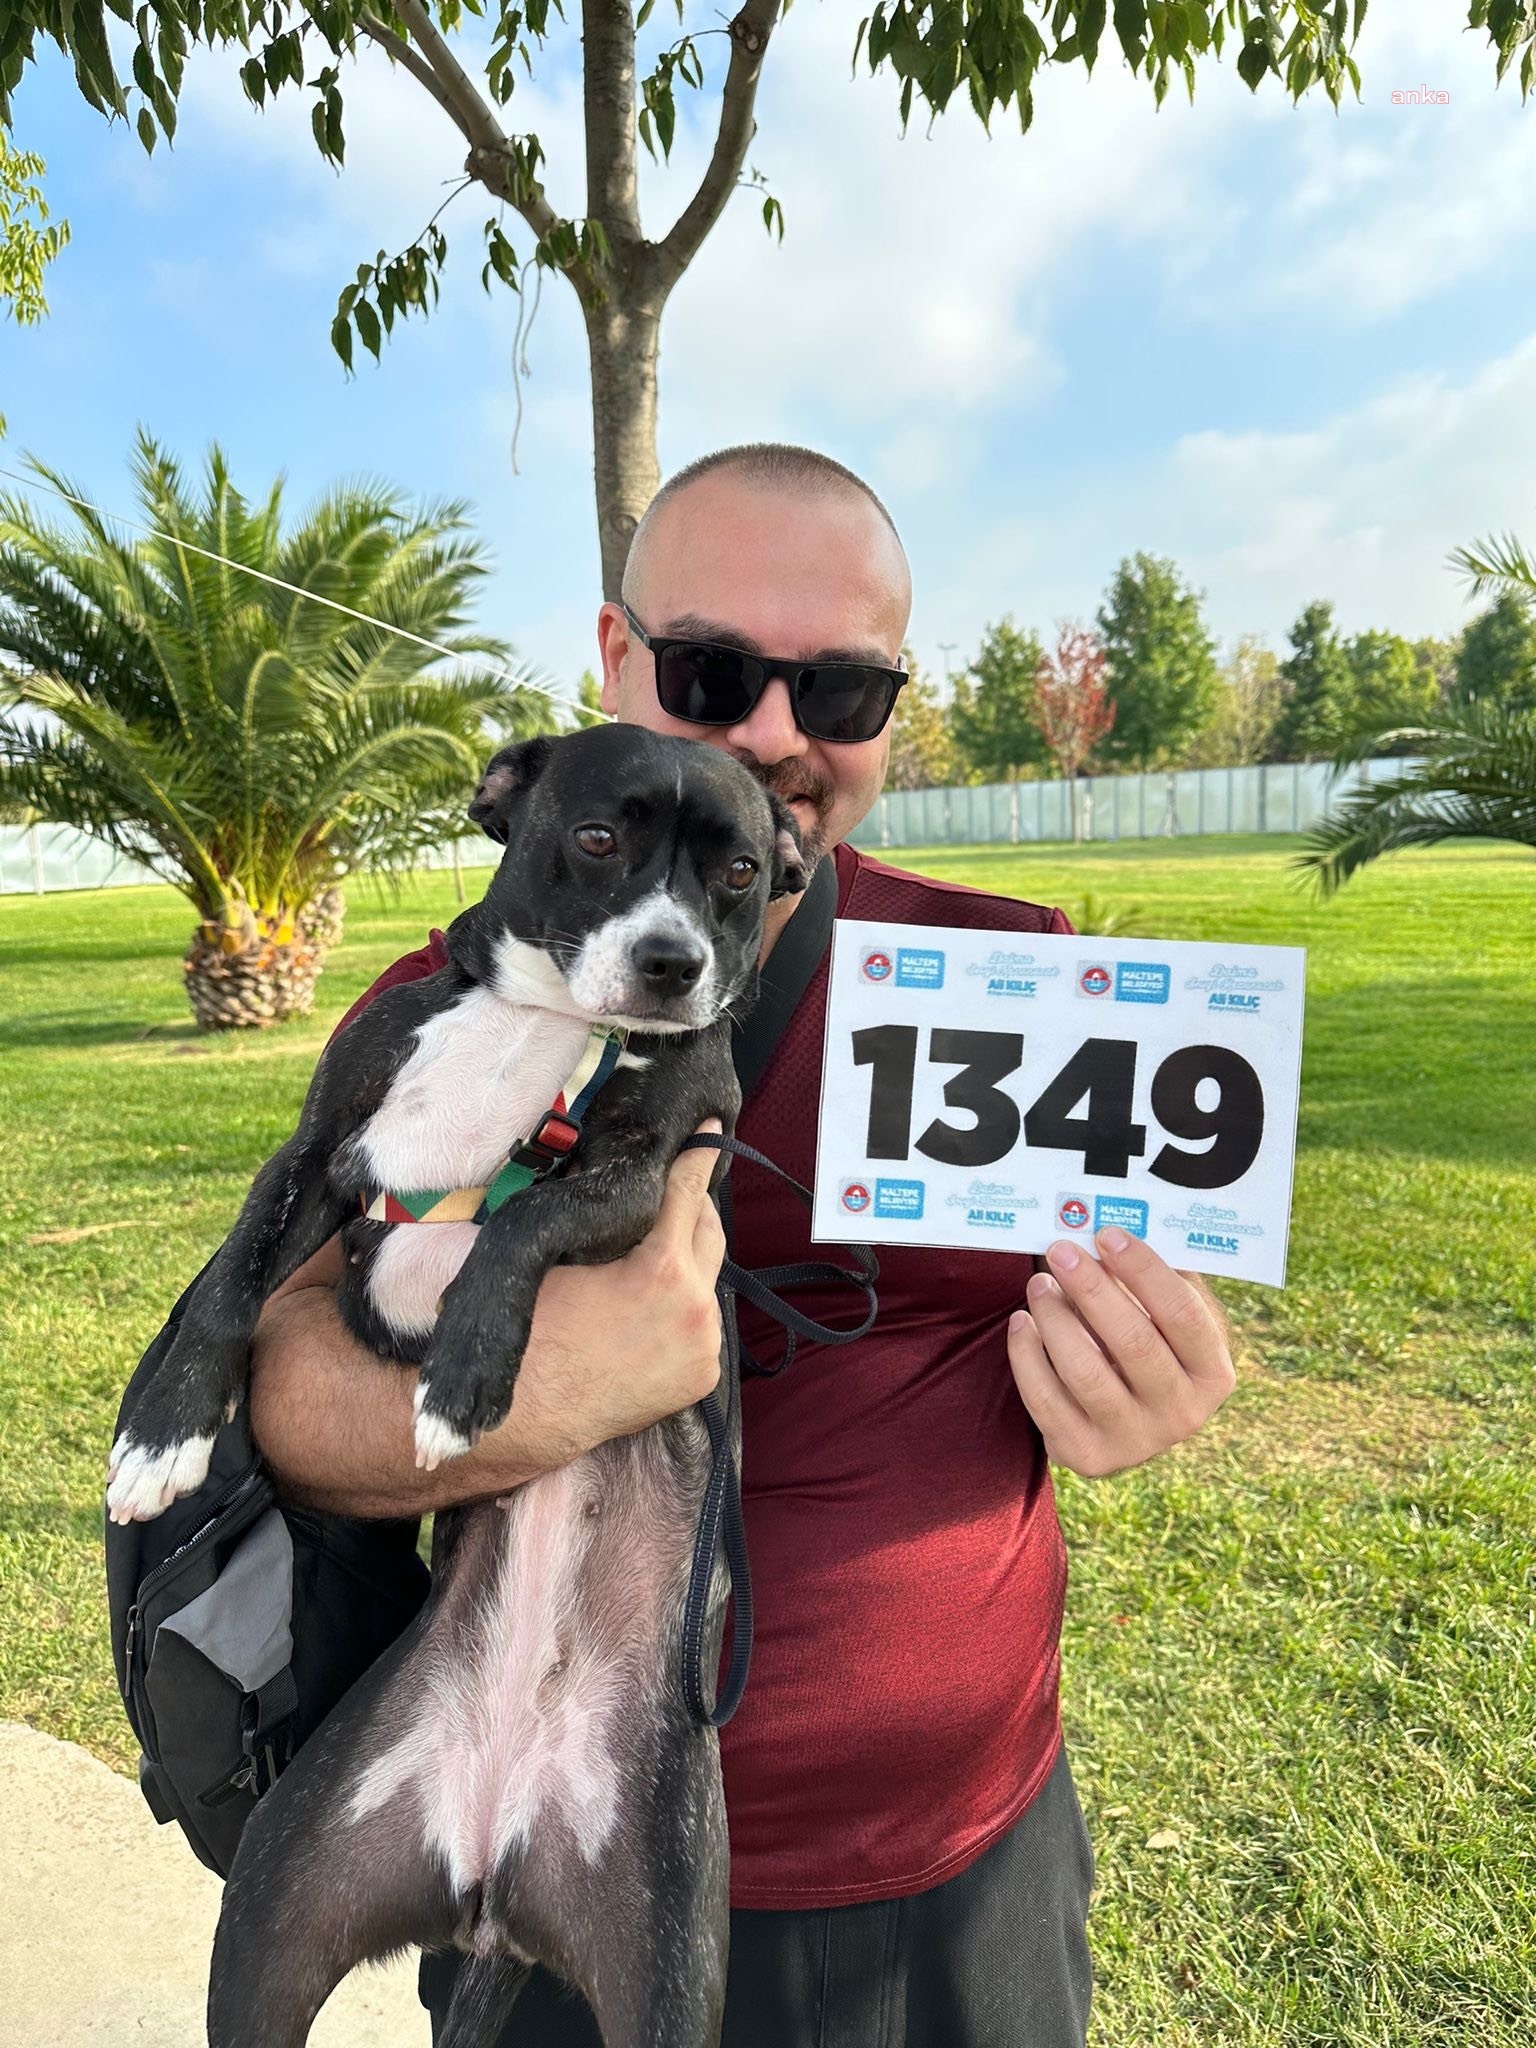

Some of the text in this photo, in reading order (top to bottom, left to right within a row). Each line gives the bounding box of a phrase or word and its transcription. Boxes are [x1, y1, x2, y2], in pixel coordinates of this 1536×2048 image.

[901, 956, 939, 968] MALTEPE
[1121, 971, 1164, 982] MALTEPE
[851, 1024, 1264, 1190] 1349
[880, 1187, 919, 1198] MALTEPE
[1101, 1204, 1143, 1218] MALTEPE
